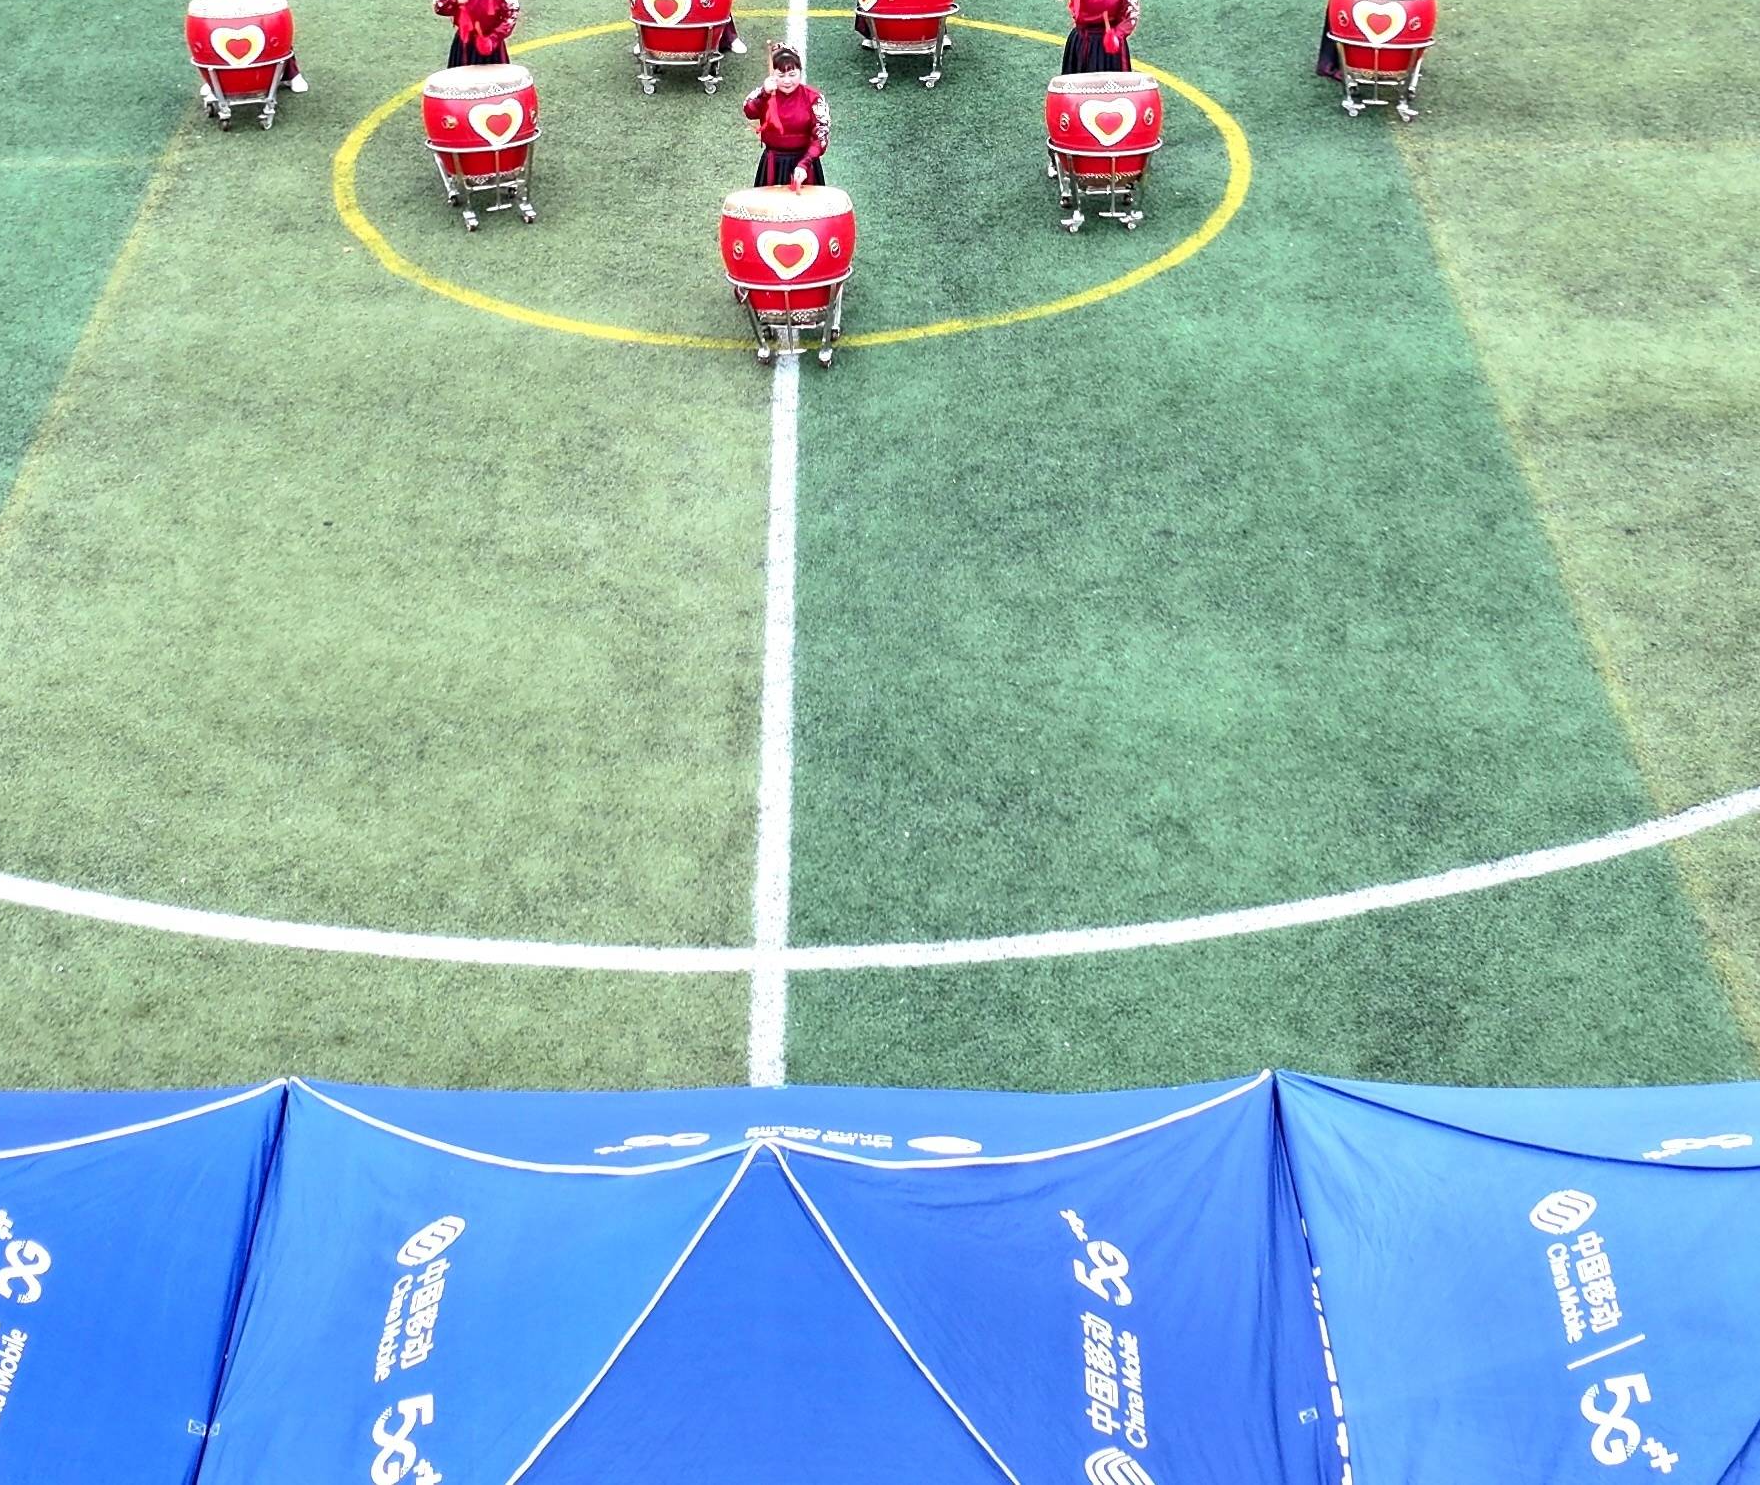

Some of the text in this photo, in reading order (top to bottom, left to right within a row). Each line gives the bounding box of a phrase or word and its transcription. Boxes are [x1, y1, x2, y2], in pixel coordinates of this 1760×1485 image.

[400, 1258, 451, 1370] 中国移动
[1569, 1231, 1623, 1333] 中国移动
[1079, 1312, 1121, 1436] 中国移动
